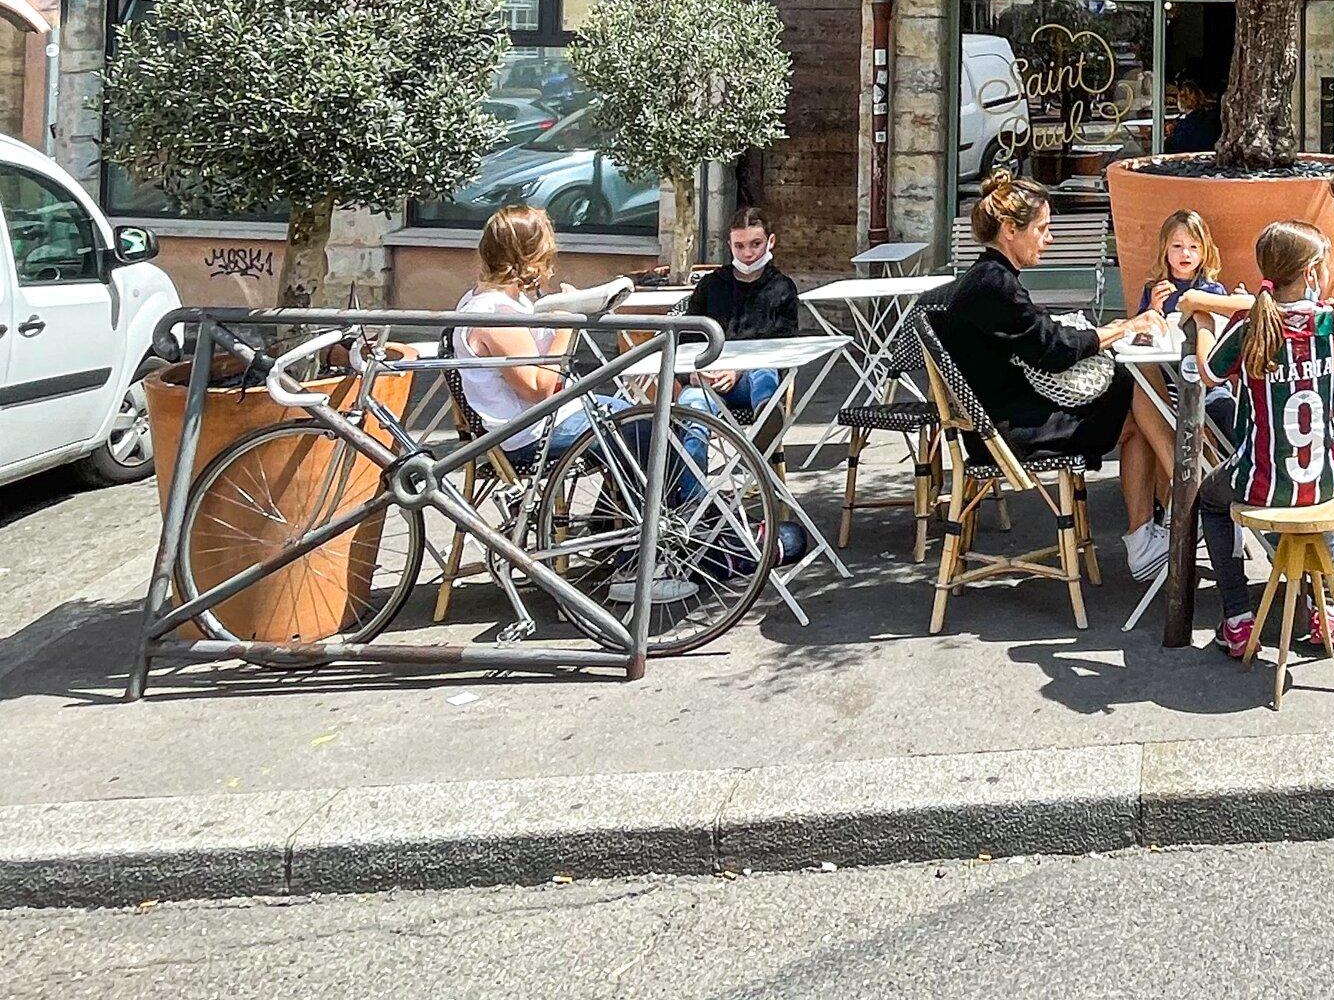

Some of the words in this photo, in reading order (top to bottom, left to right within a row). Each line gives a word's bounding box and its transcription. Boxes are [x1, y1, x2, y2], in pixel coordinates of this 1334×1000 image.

[979, 23, 1115, 115] Saint
[998, 82, 1134, 162] Paul
[1267, 356, 1334, 384] MARIA
[1283, 390, 1325, 483] 9
